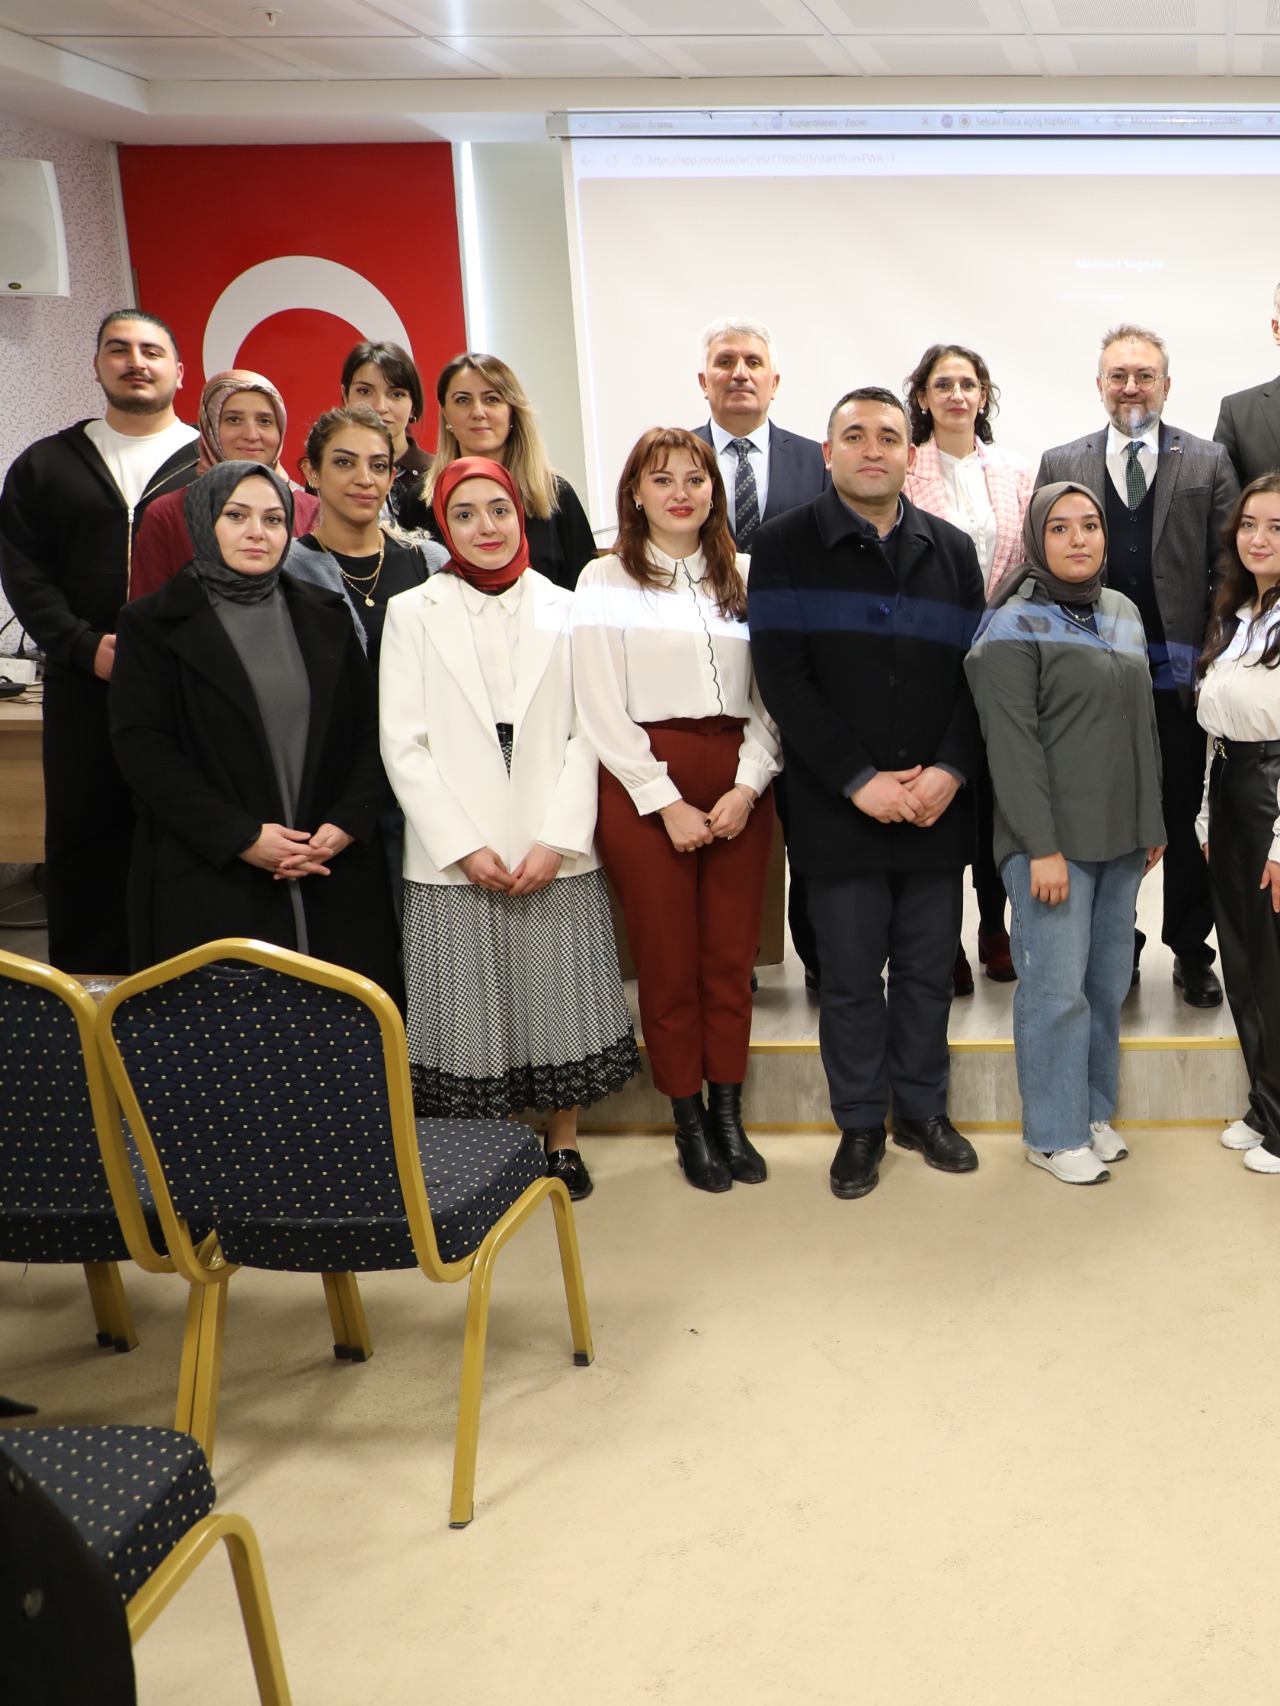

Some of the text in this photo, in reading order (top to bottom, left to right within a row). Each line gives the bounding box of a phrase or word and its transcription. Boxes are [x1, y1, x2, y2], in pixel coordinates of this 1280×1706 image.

[619, 121, 641, 129] zoom
[648, 120, 674, 129] Arama
[845, 118, 868, 127] Zoom
[1003, 116, 1022, 126] hoca
